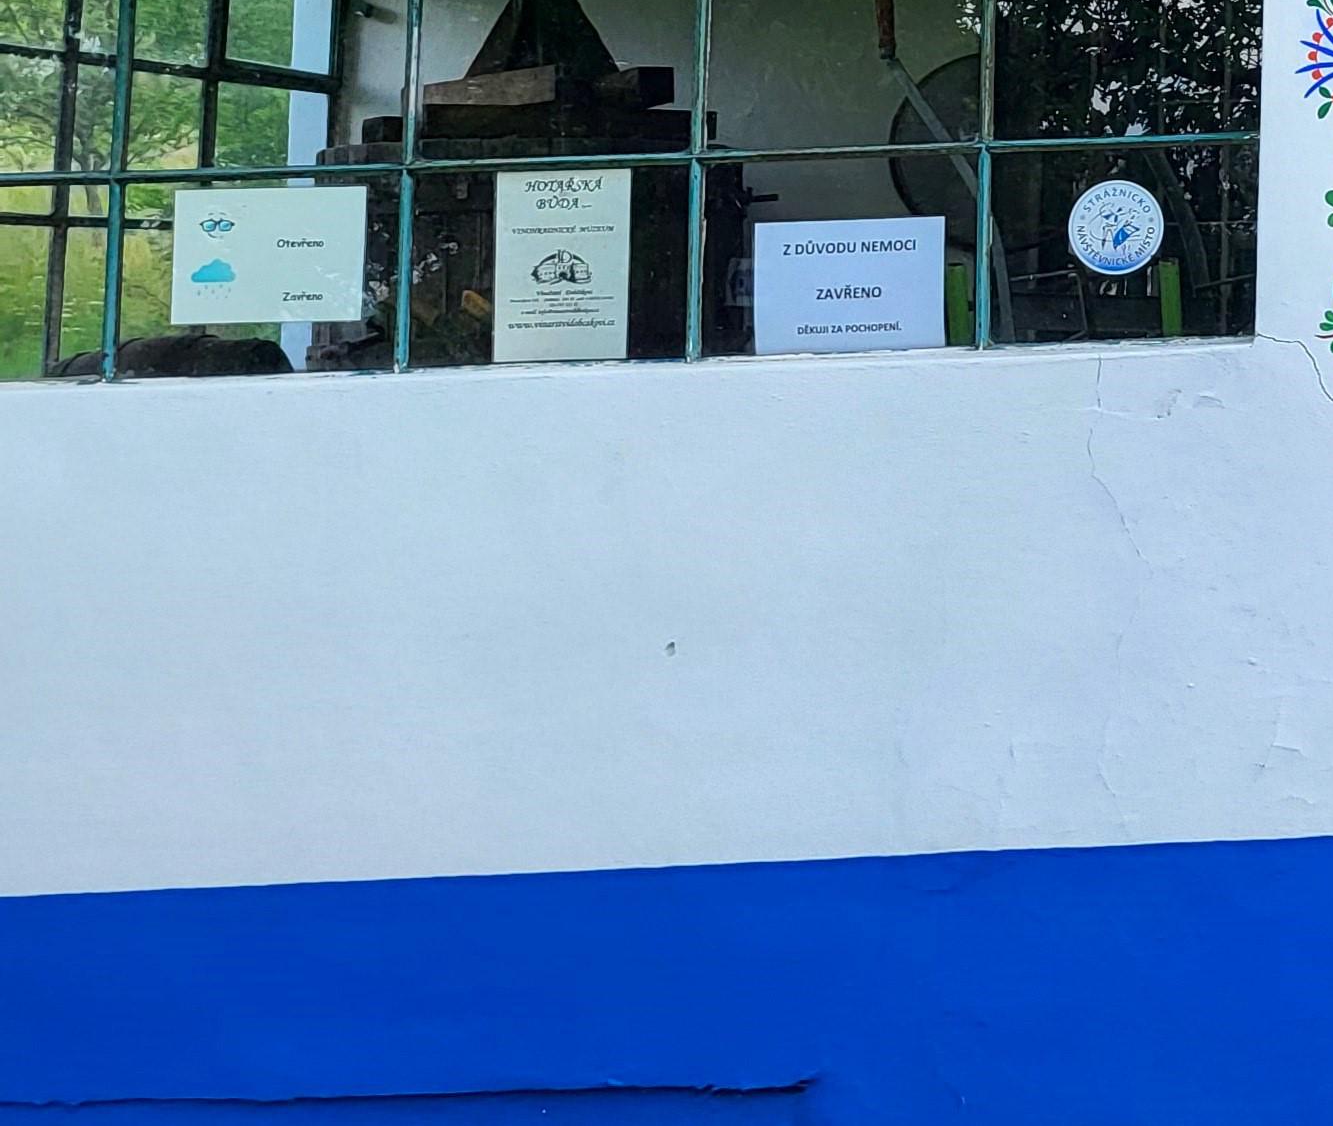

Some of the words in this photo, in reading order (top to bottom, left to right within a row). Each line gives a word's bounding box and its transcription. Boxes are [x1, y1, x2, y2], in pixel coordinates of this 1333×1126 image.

[524, 176, 604, 193] HOTAŘSKÁ
[579, 224, 615, 233] MUZEUM
[277, 238, 324, 248] Otevřeno
[783, 244, 791, 256] Z
[795, 239, 857, 255] DŮVODU
[860, 238, 917, 253] NEMOCI
[1134, 226, 1156, 258] MÍSTO
[282, 291, 324, 302] Zavřeno
[815, 284, 882, 300] ZAVŘENO
[797, 324, 829, 335] DĚKUJI
[831, 323, 844, 334] ZA
[845, 320, 902, 333] POCHOPENÍ.
